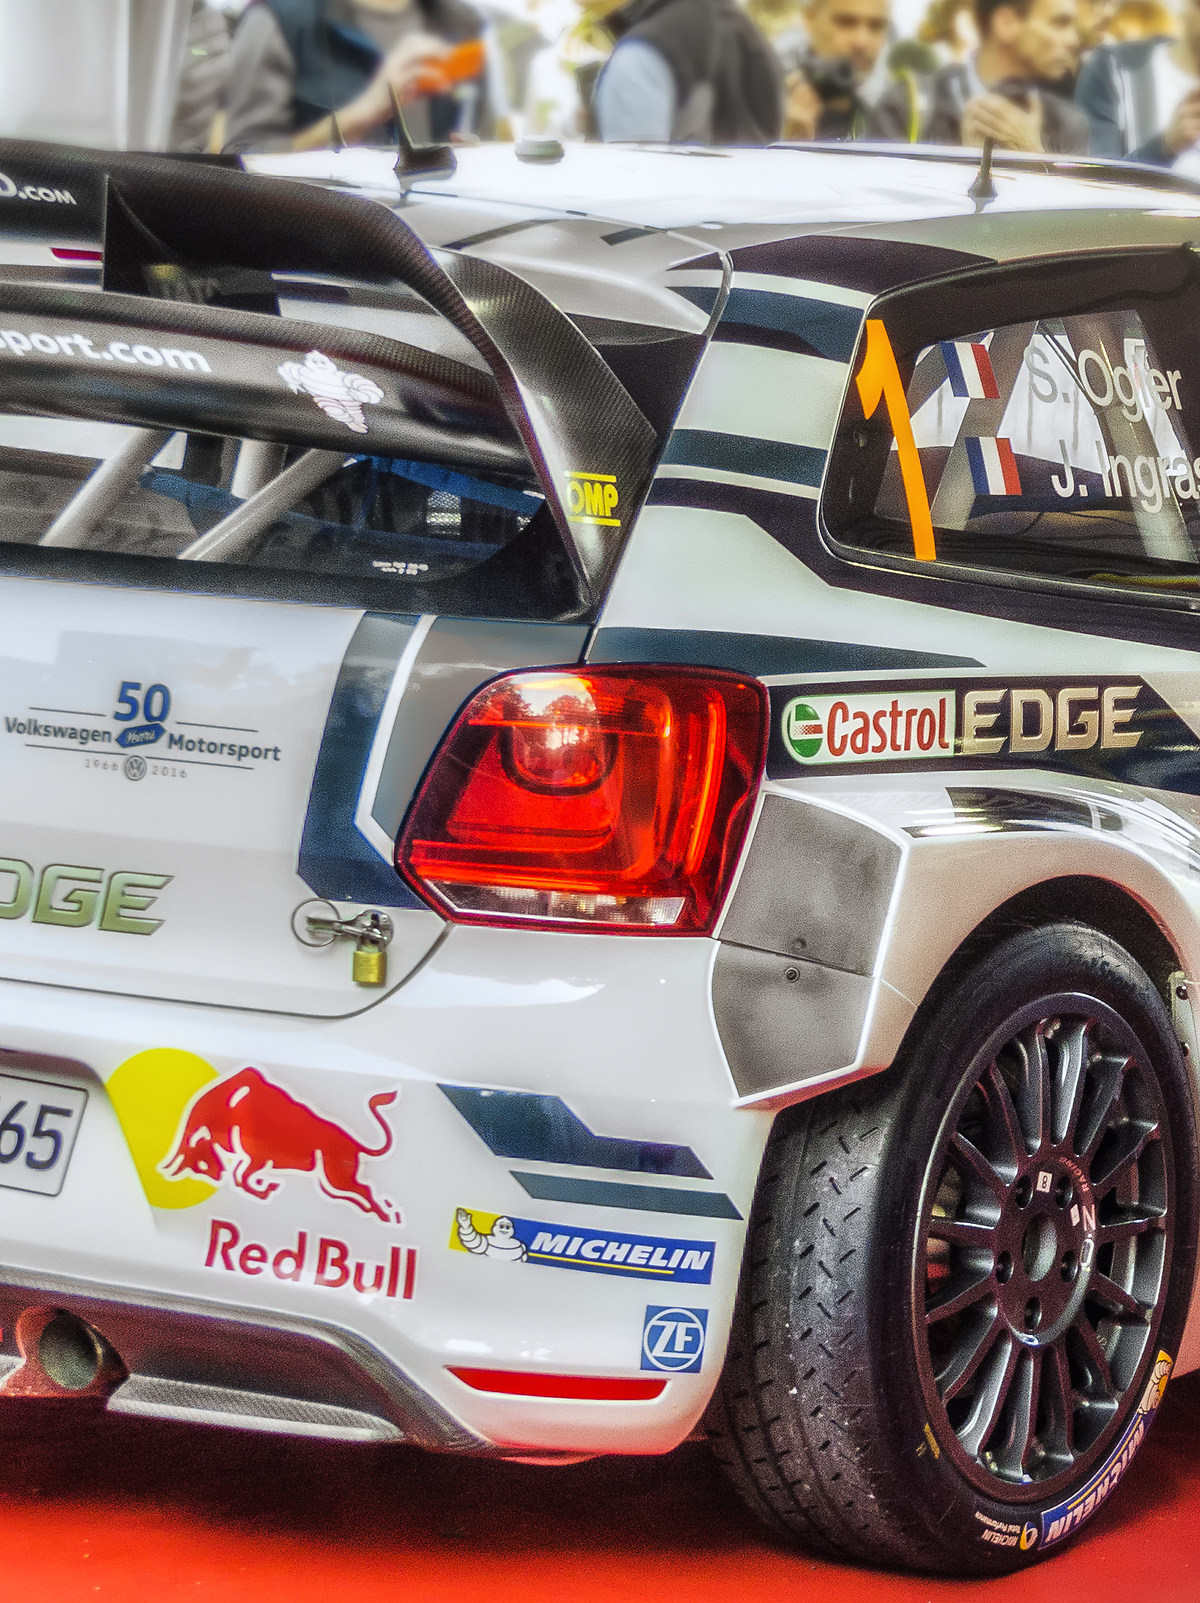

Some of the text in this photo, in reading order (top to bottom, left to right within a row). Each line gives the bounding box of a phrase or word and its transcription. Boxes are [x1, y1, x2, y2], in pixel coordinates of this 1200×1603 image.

[1023, 345, 1071, 404] S.
[855, 319, 937, 562] 1
[1051, 439, 1089, 498] J.
[566, 480, 619, 517] OMP
[113, 681, 171, 723] 50
[826, 684, 1144, 757] Castrol EDGE
[4, 716, 281, 762] Volkswagen Motorsport
[84, 758, 119, 772] 1966
[152, 765, 188, 779] 2016
[0, 1100, 74, 1171] 65
[1059, 1157, 1090, 1192] RACING
[204, 1218, 417, 1300] Red Bull
[530, 1231, 711, 1270] MICHELIN
[651, 1318, 704, 1360] ZF
[1047, 1421, 1145, 1543] MICHELIN
[981, 1528, 1019, 1547] MICHELIN
